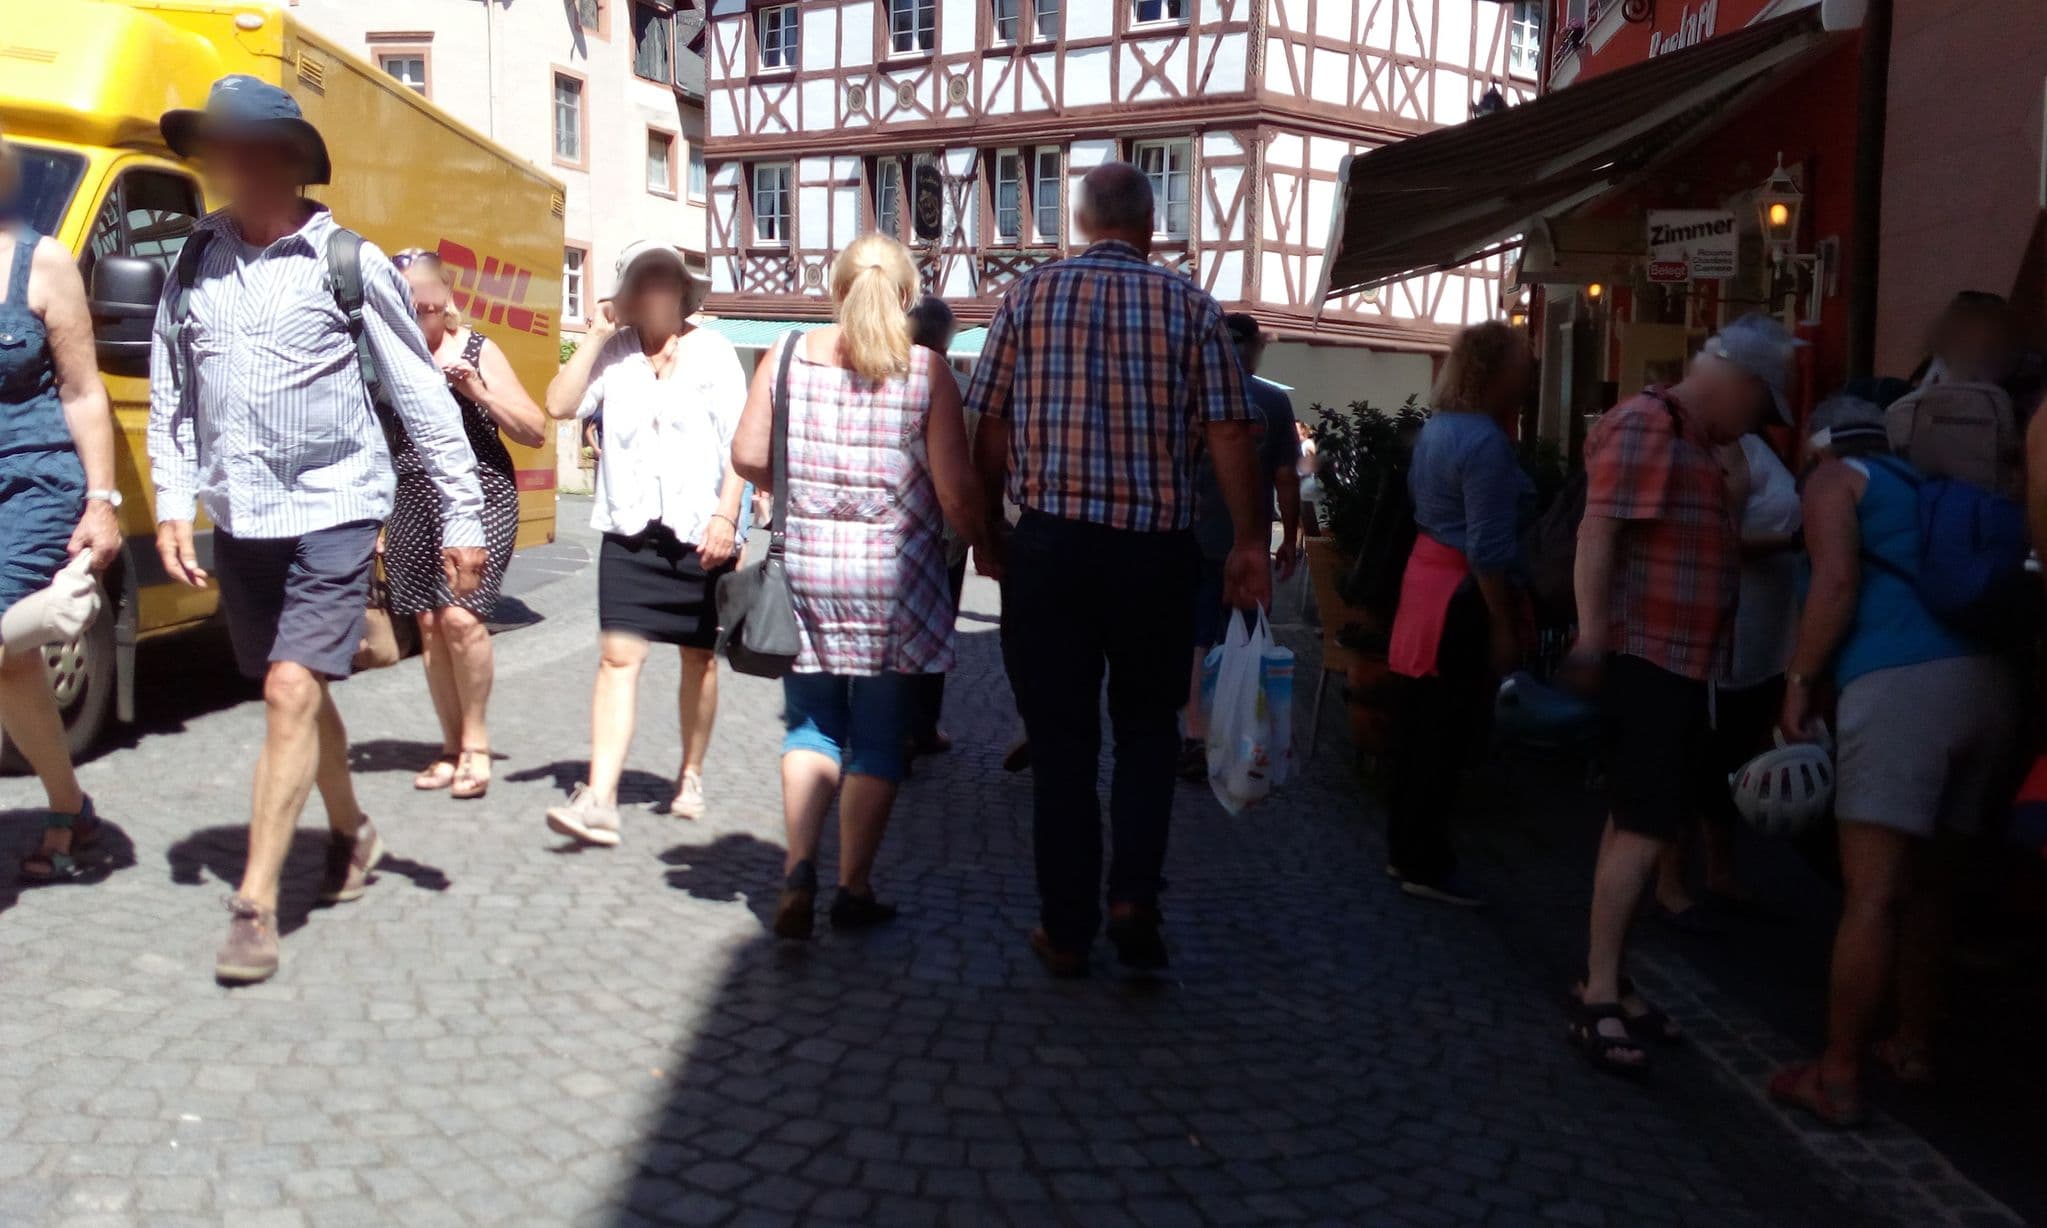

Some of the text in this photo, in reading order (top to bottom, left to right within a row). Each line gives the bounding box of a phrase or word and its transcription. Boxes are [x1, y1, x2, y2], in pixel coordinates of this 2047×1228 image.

[1651, 218, 1734, 245] Zimmer
[1650, 264, 1686, 277] Belegt
[439, 238, 535, 332] DHL
